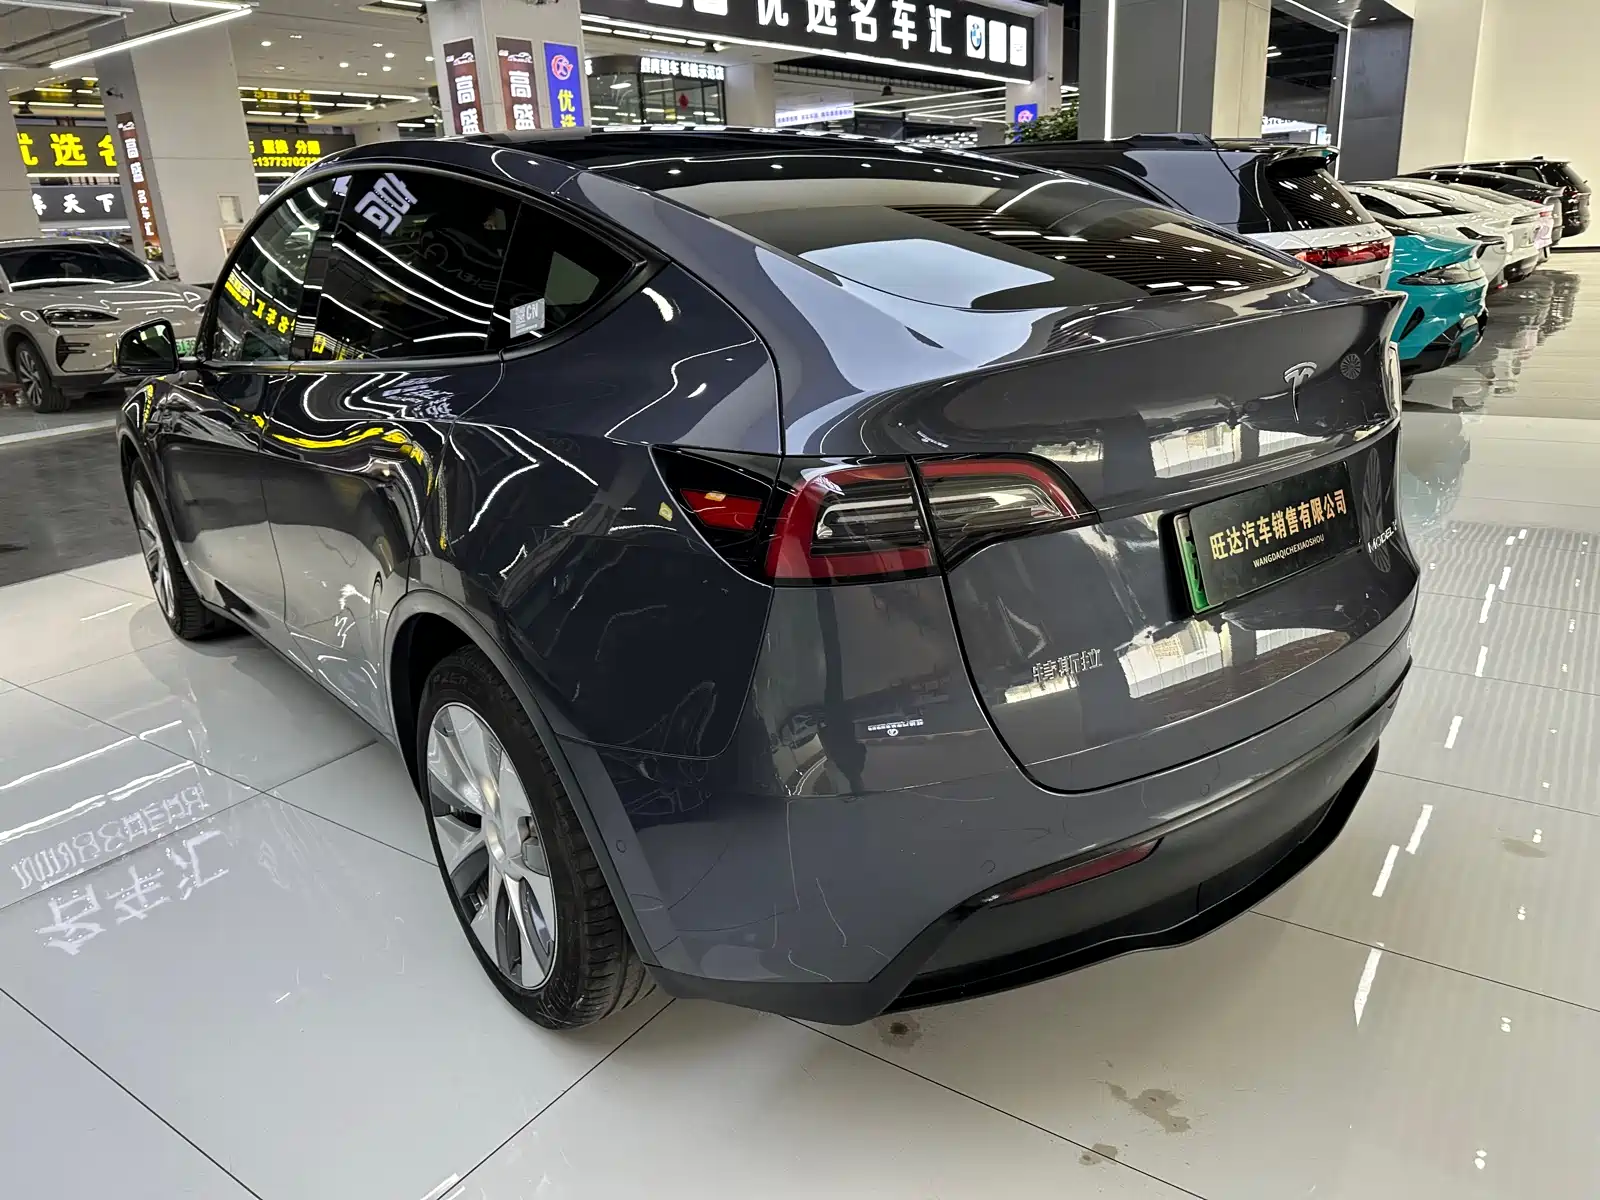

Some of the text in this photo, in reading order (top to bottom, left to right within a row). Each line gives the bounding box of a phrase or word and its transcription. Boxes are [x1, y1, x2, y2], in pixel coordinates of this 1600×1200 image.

[454, 75, 481, 134] 高盛
[508, 70, 535, 130] 高盛
[1209, 489, 1347, 560] 旺达汽车销售有限公司
[1253, 533, 1325, 568] WANGDAQICHEXIAOSHOU
[1367, 526, 1394, 554] MODEL
